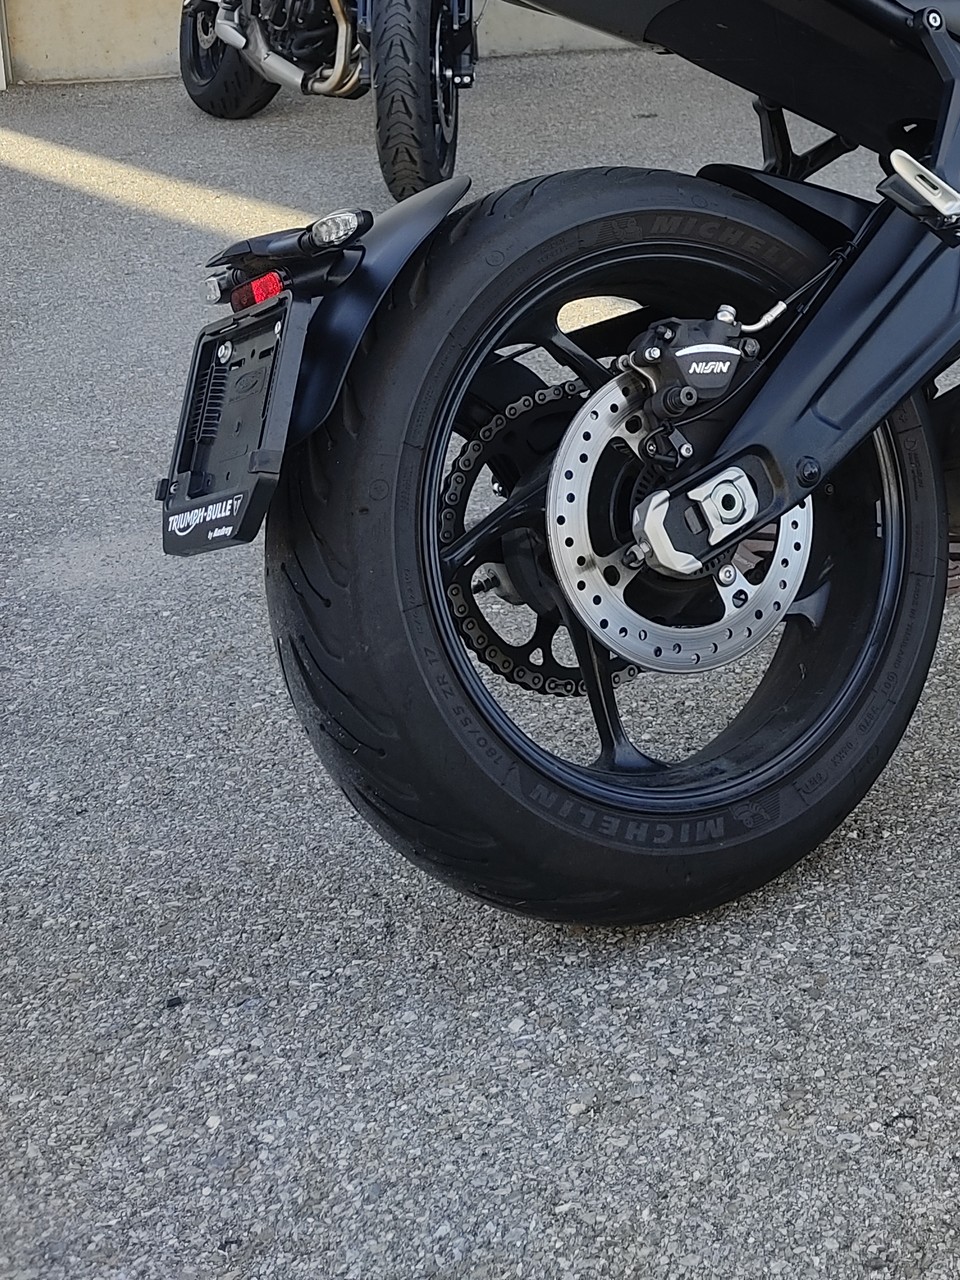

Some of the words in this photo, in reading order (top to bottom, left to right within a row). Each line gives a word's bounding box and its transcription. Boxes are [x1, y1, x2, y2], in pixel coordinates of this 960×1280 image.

[422, 646, 441, 666] 17
[436, 673, 455, 700] ZR
[452, 704, 504, 767] 180/55
[527, 782, 726, 845] MICHELIN
